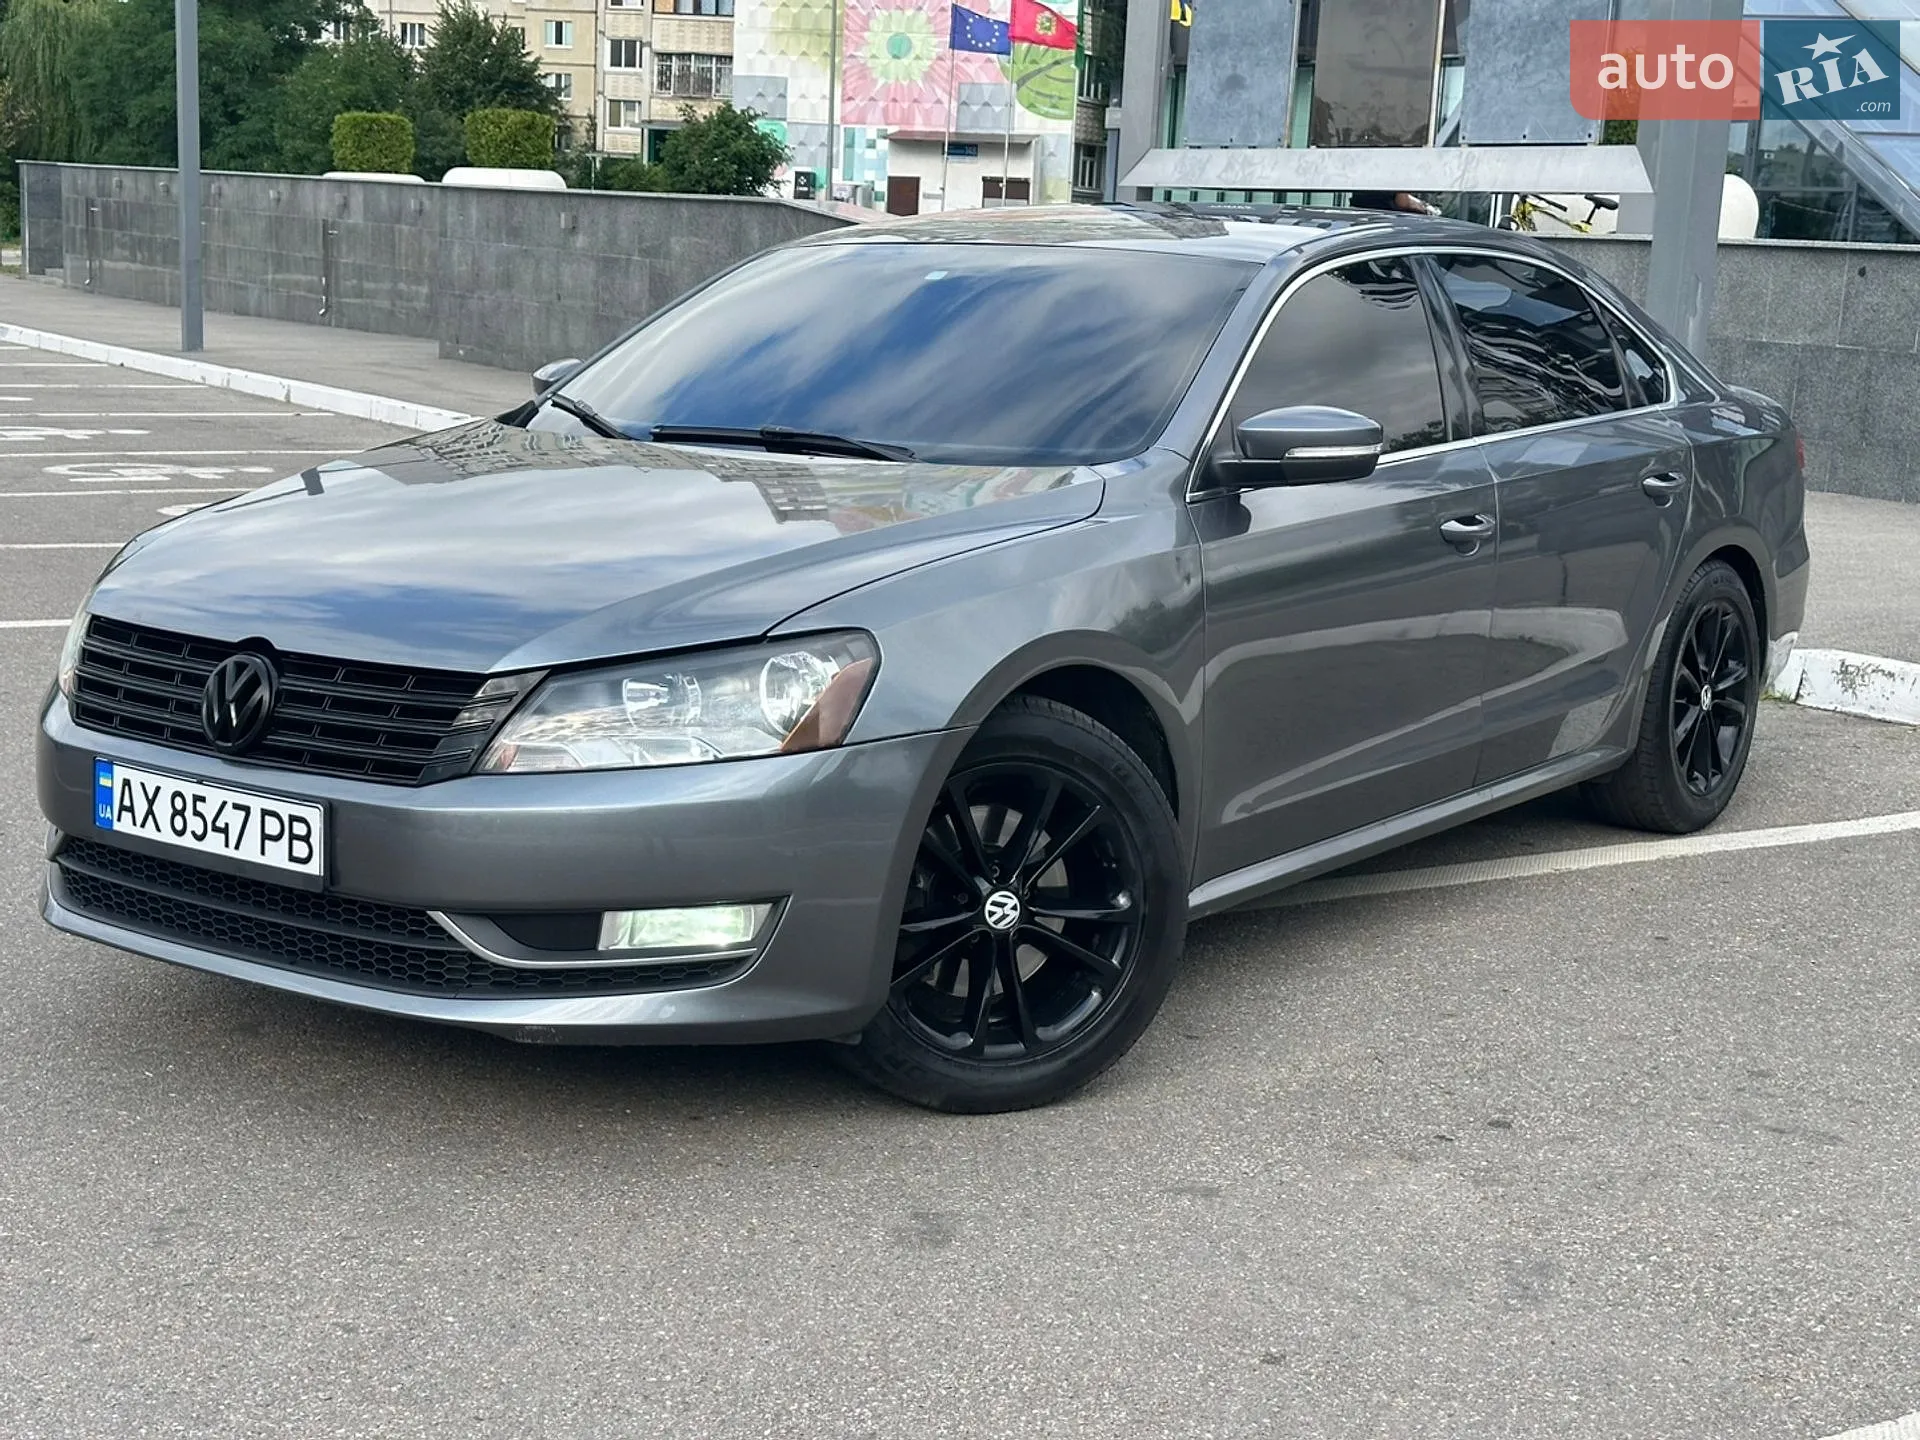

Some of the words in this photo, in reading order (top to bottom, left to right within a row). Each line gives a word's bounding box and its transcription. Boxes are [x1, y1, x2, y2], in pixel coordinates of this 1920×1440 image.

[98, 803, 112, 820] UA
[116, 778, 162, 833] AX
[170, 790, 251, 851] 8547
[260, 808, 313, 865] PB
